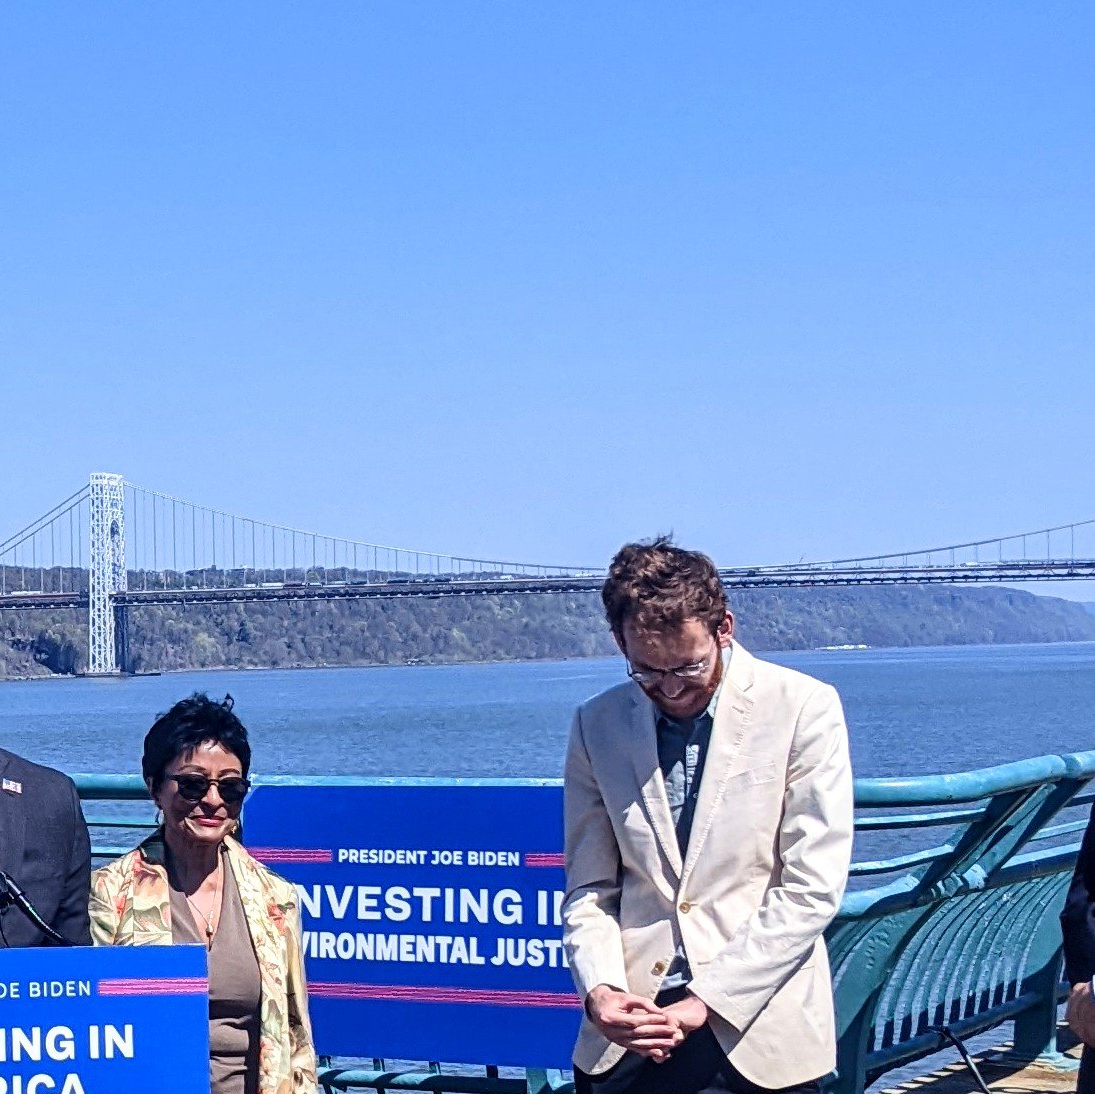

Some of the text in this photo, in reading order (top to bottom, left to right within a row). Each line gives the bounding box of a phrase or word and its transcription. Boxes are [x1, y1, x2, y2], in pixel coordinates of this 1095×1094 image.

[338, 848, 520, 867] PRESIDENT JOE BIDEN
[294, 884, 523, 925] NVESTING
[302, 930, 571, 968] IRONMENTAL JUST
[29, 980, 91, 998] BIDEN
[89, 1024, 134, 1059] IN
